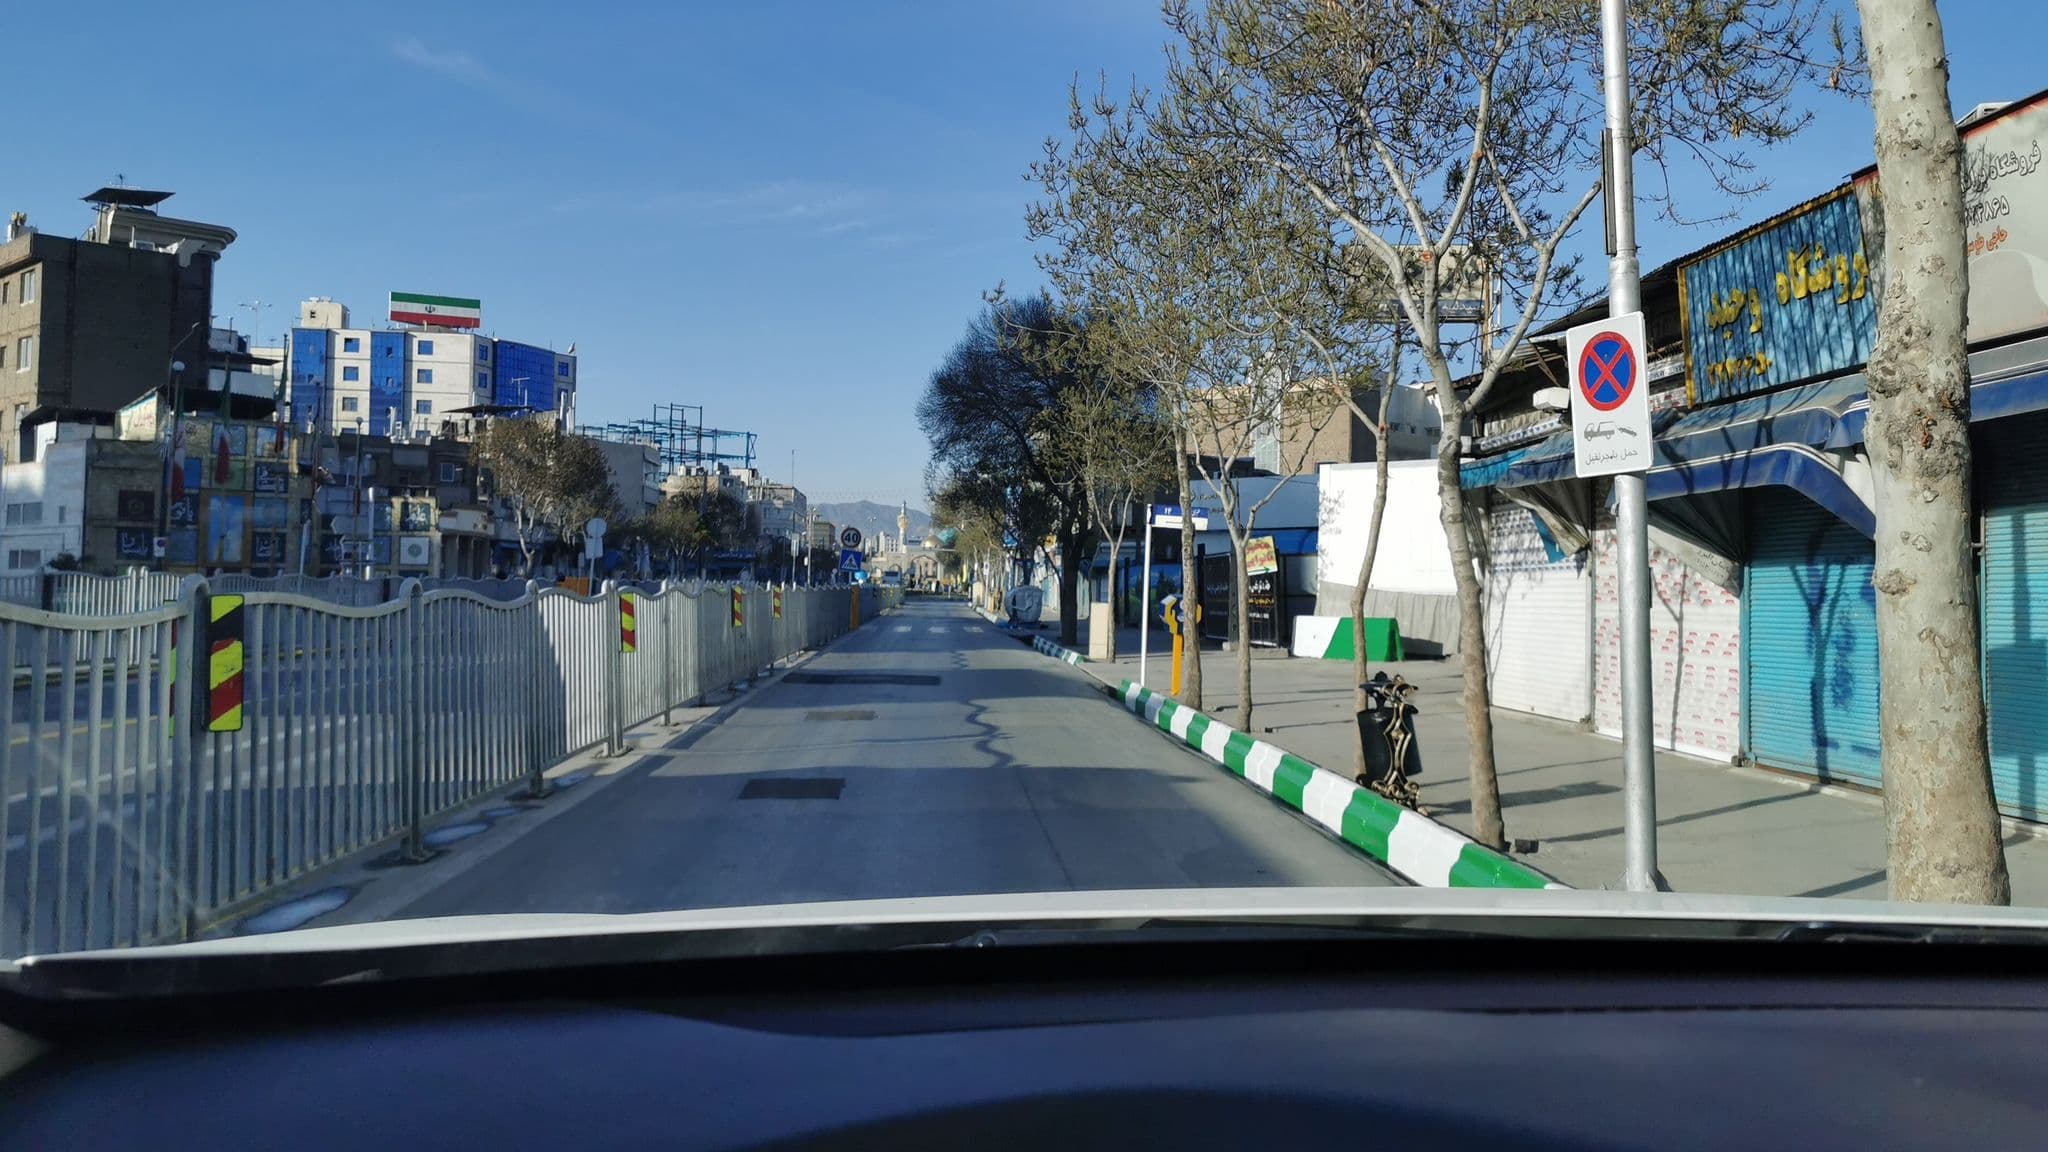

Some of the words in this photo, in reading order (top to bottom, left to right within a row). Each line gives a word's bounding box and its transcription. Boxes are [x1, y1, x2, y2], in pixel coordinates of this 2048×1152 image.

[1989, 140, 2041, 180] فروشگاه
[1621, 448, 1638, 461] حمل
[845, 533, 859, 543] 40
